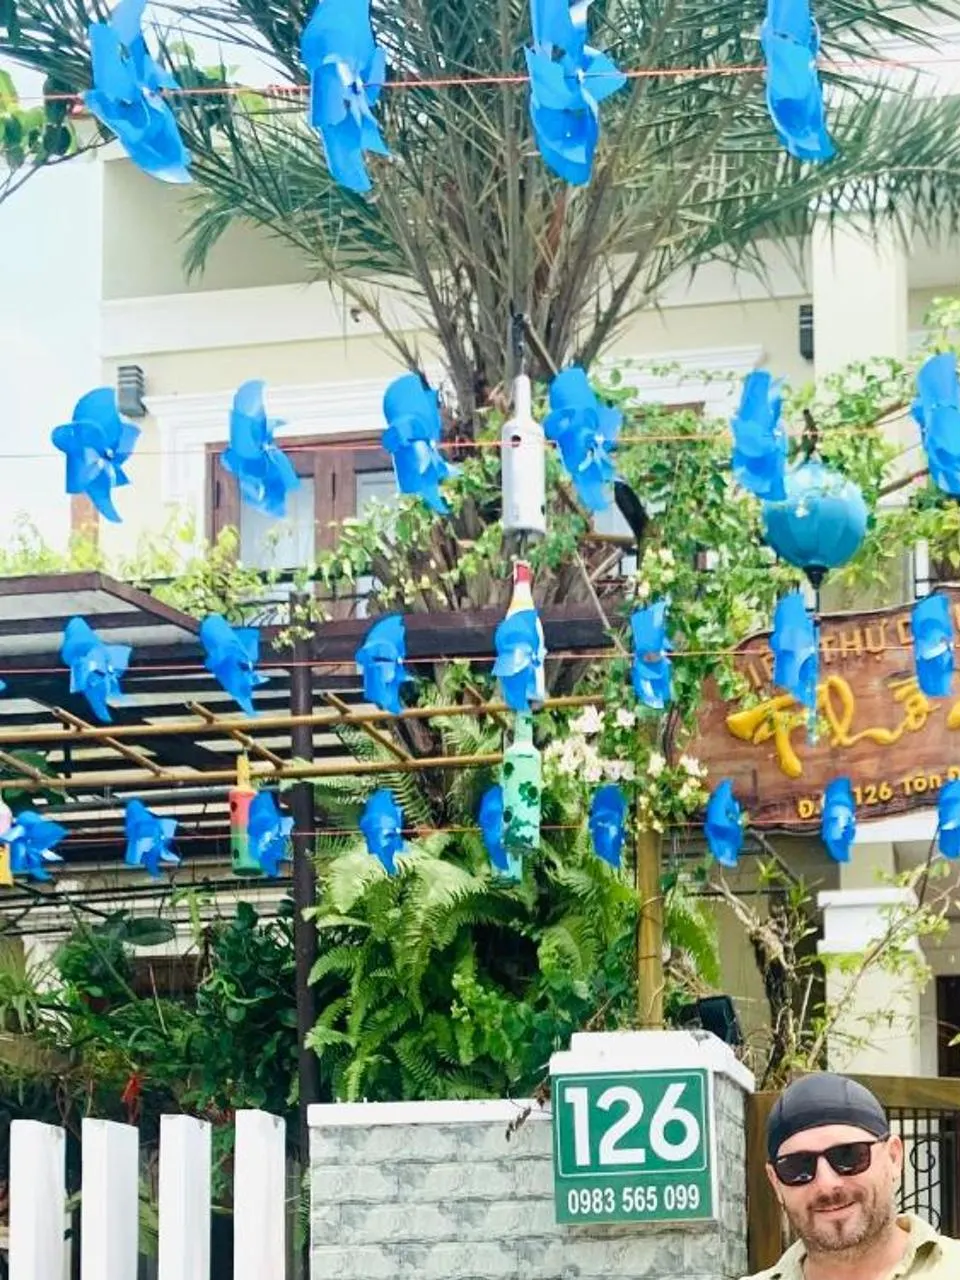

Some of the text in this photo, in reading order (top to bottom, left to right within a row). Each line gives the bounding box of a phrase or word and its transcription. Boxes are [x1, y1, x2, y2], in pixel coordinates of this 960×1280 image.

[854, 782, 893, 806] 126
[564, 1082, 700, 1166] 126
[567, 1183, 700, 1215] 0983 565 099
